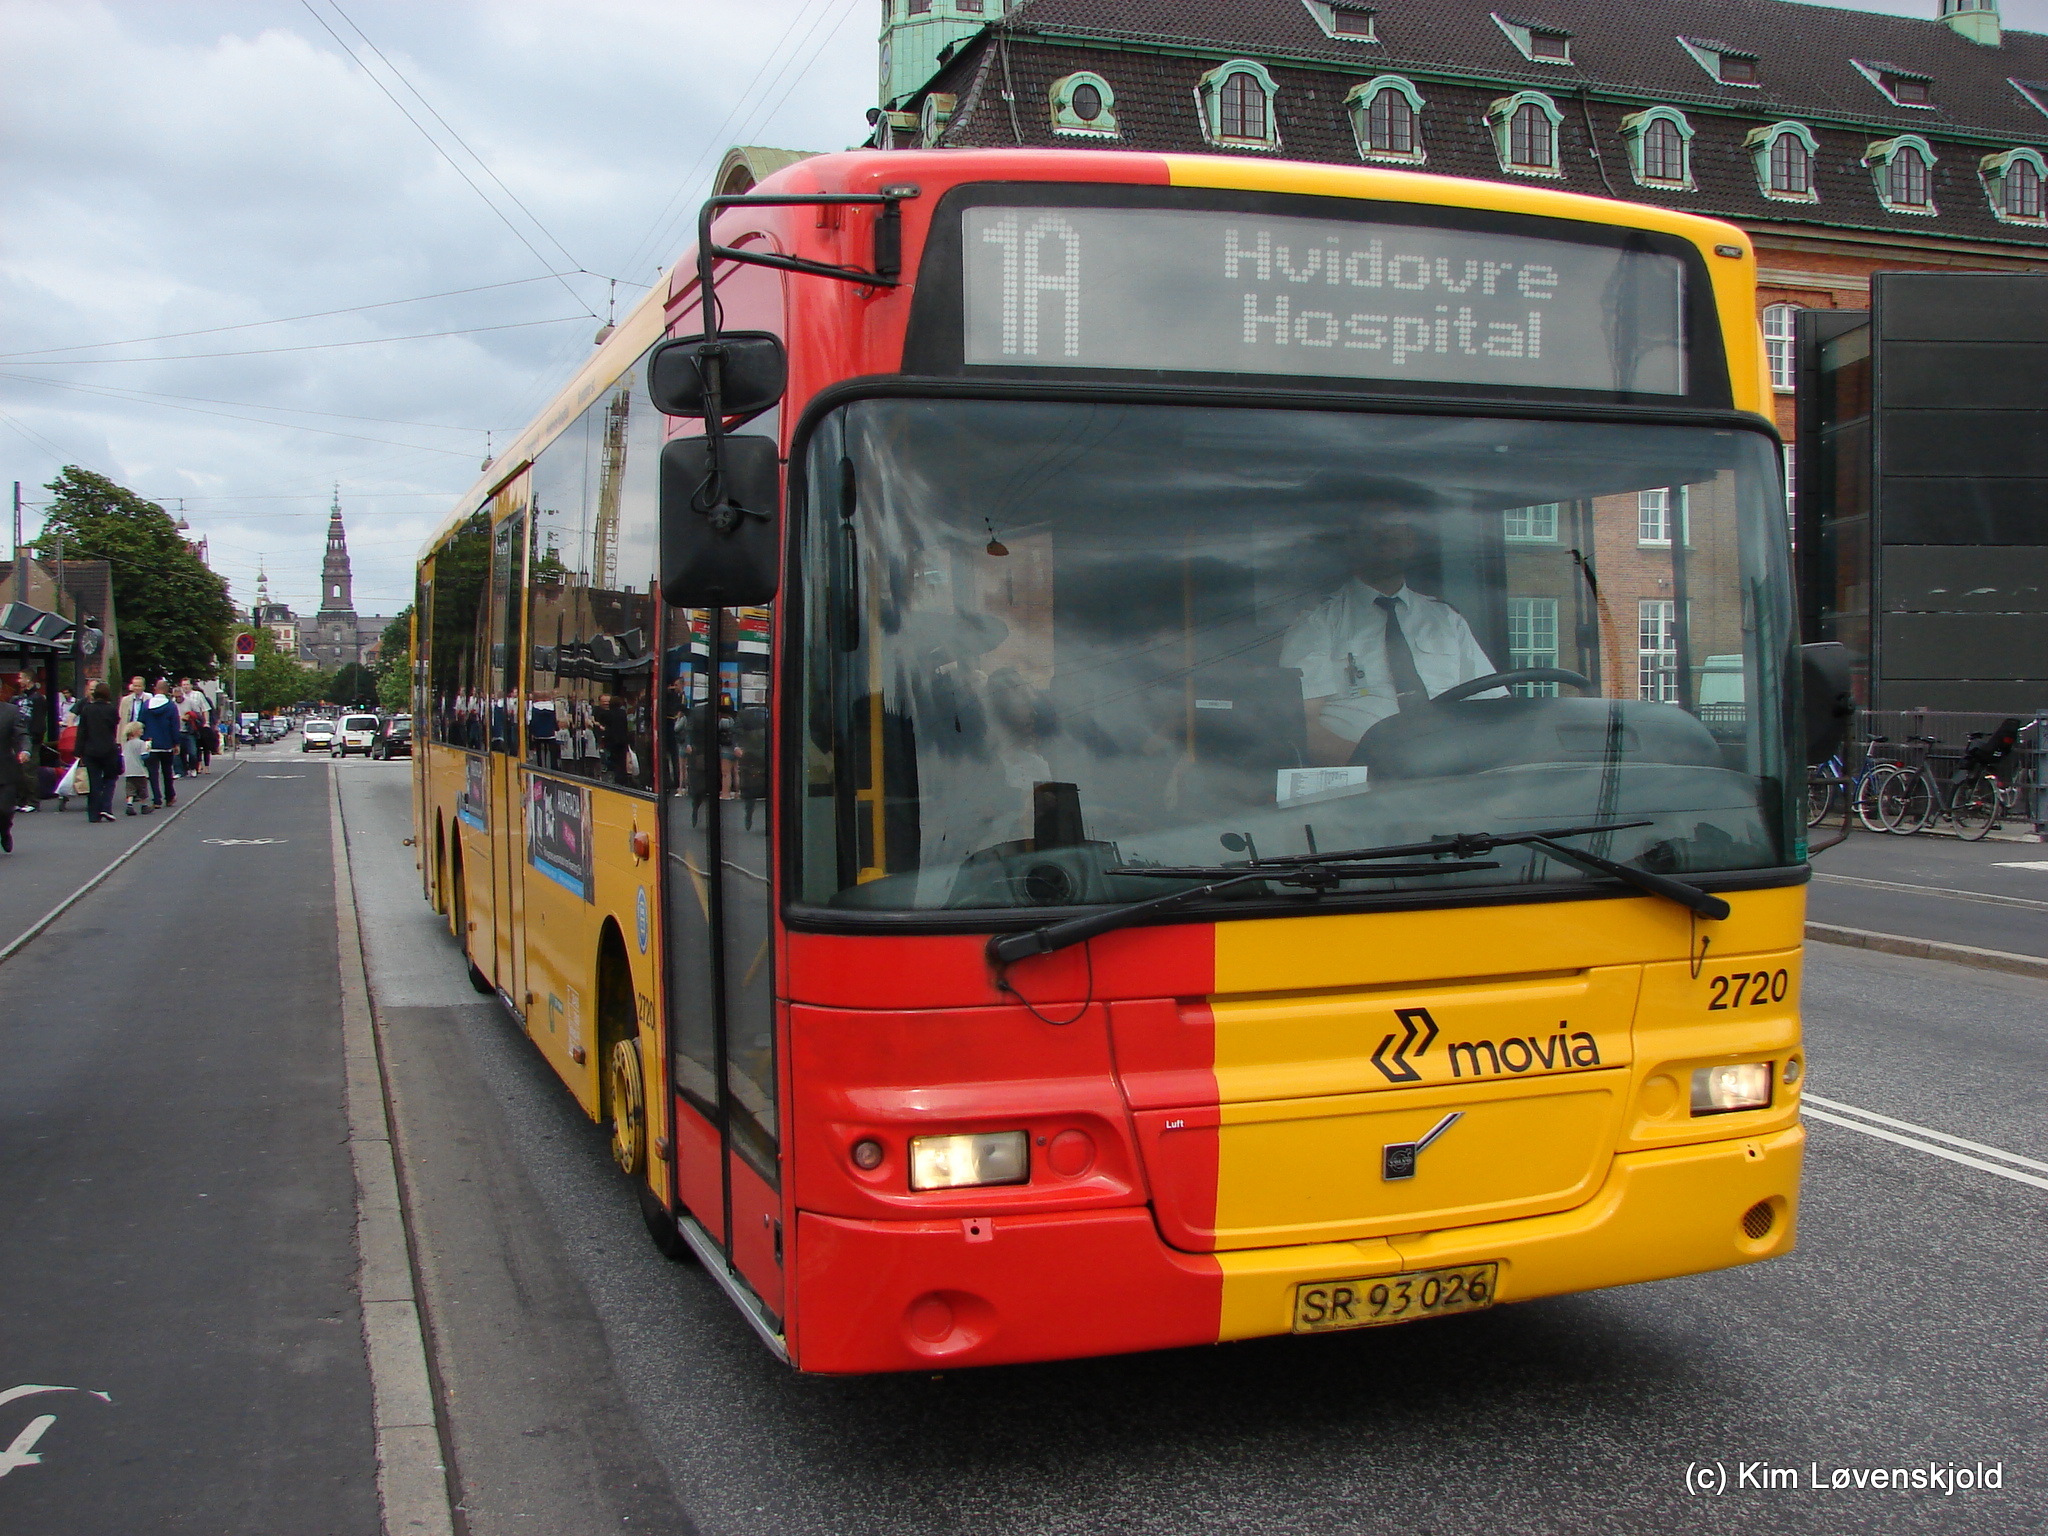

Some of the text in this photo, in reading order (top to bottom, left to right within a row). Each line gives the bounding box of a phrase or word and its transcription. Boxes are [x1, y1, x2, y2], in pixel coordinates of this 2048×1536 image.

[983, 214, 1080, 357] 1A
[1225, 229, 1558, 299] Hvidovre
[1243, 293, 1541, 364] Hospital
[1707, 968, 1788, 1011] 2720
[1448, 1020, 1601, 1077] movia
[1166, 1119, 1184, 1128] Luft
[1302, 1271, 1487, 1323] SR 93 026
